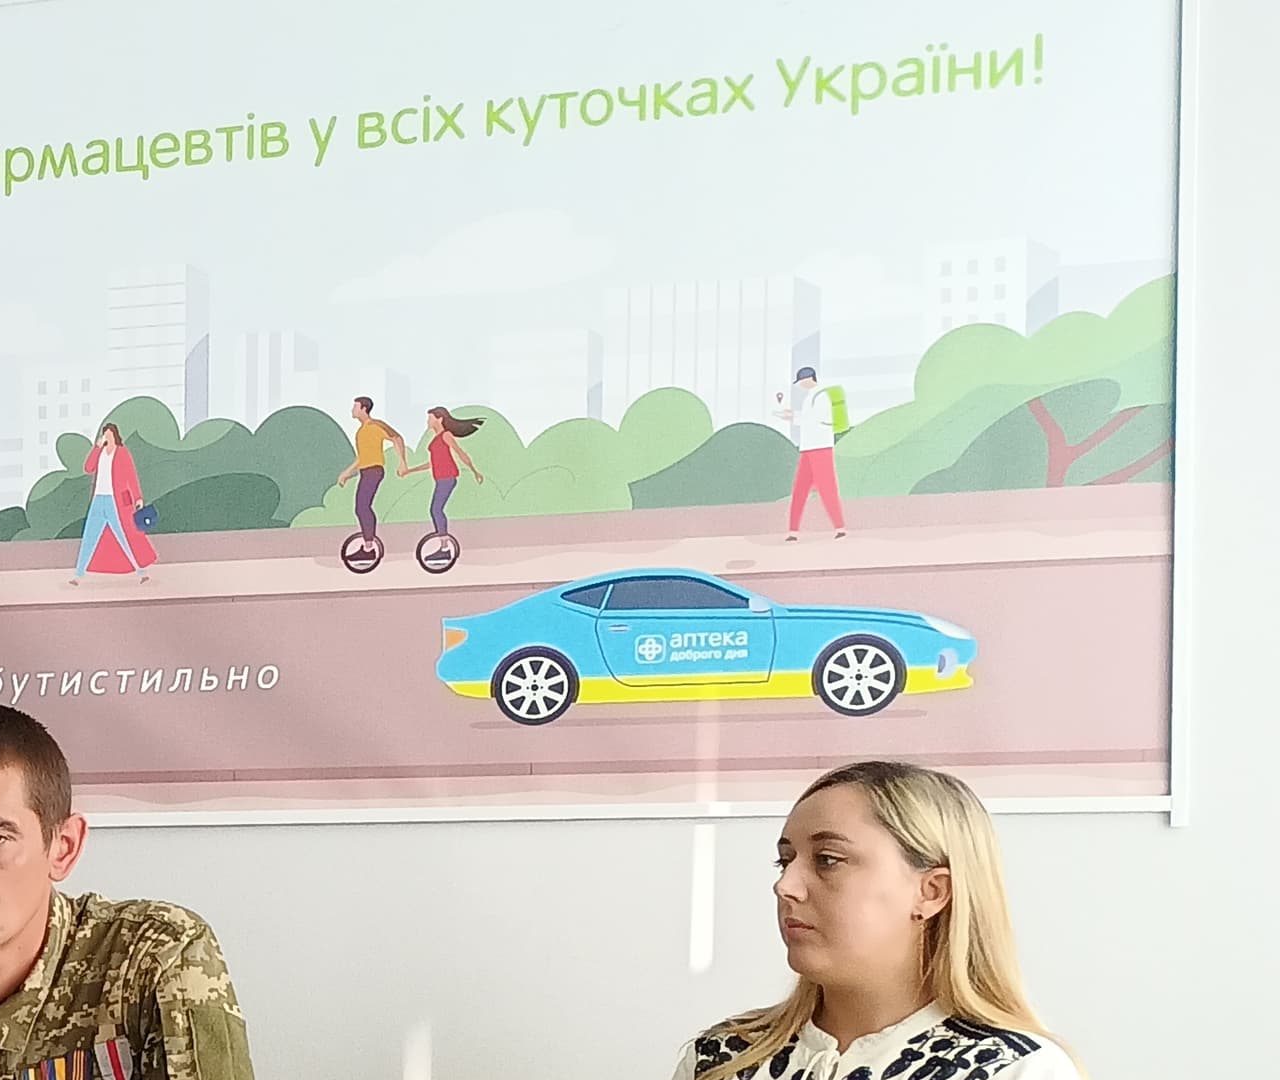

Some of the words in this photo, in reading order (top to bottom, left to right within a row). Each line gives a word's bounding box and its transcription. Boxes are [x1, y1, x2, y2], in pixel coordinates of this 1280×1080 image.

[309, 115, 337, 167] у
[357, 94, 465, 149] всіх
[485, 73, 755, 147] куточках
[776, 33, 1045, 115] України!
[670, 630, 748, 648] аптека
[669, 649, 722, 662] доброго
[724, 648, 748, 660] дня
